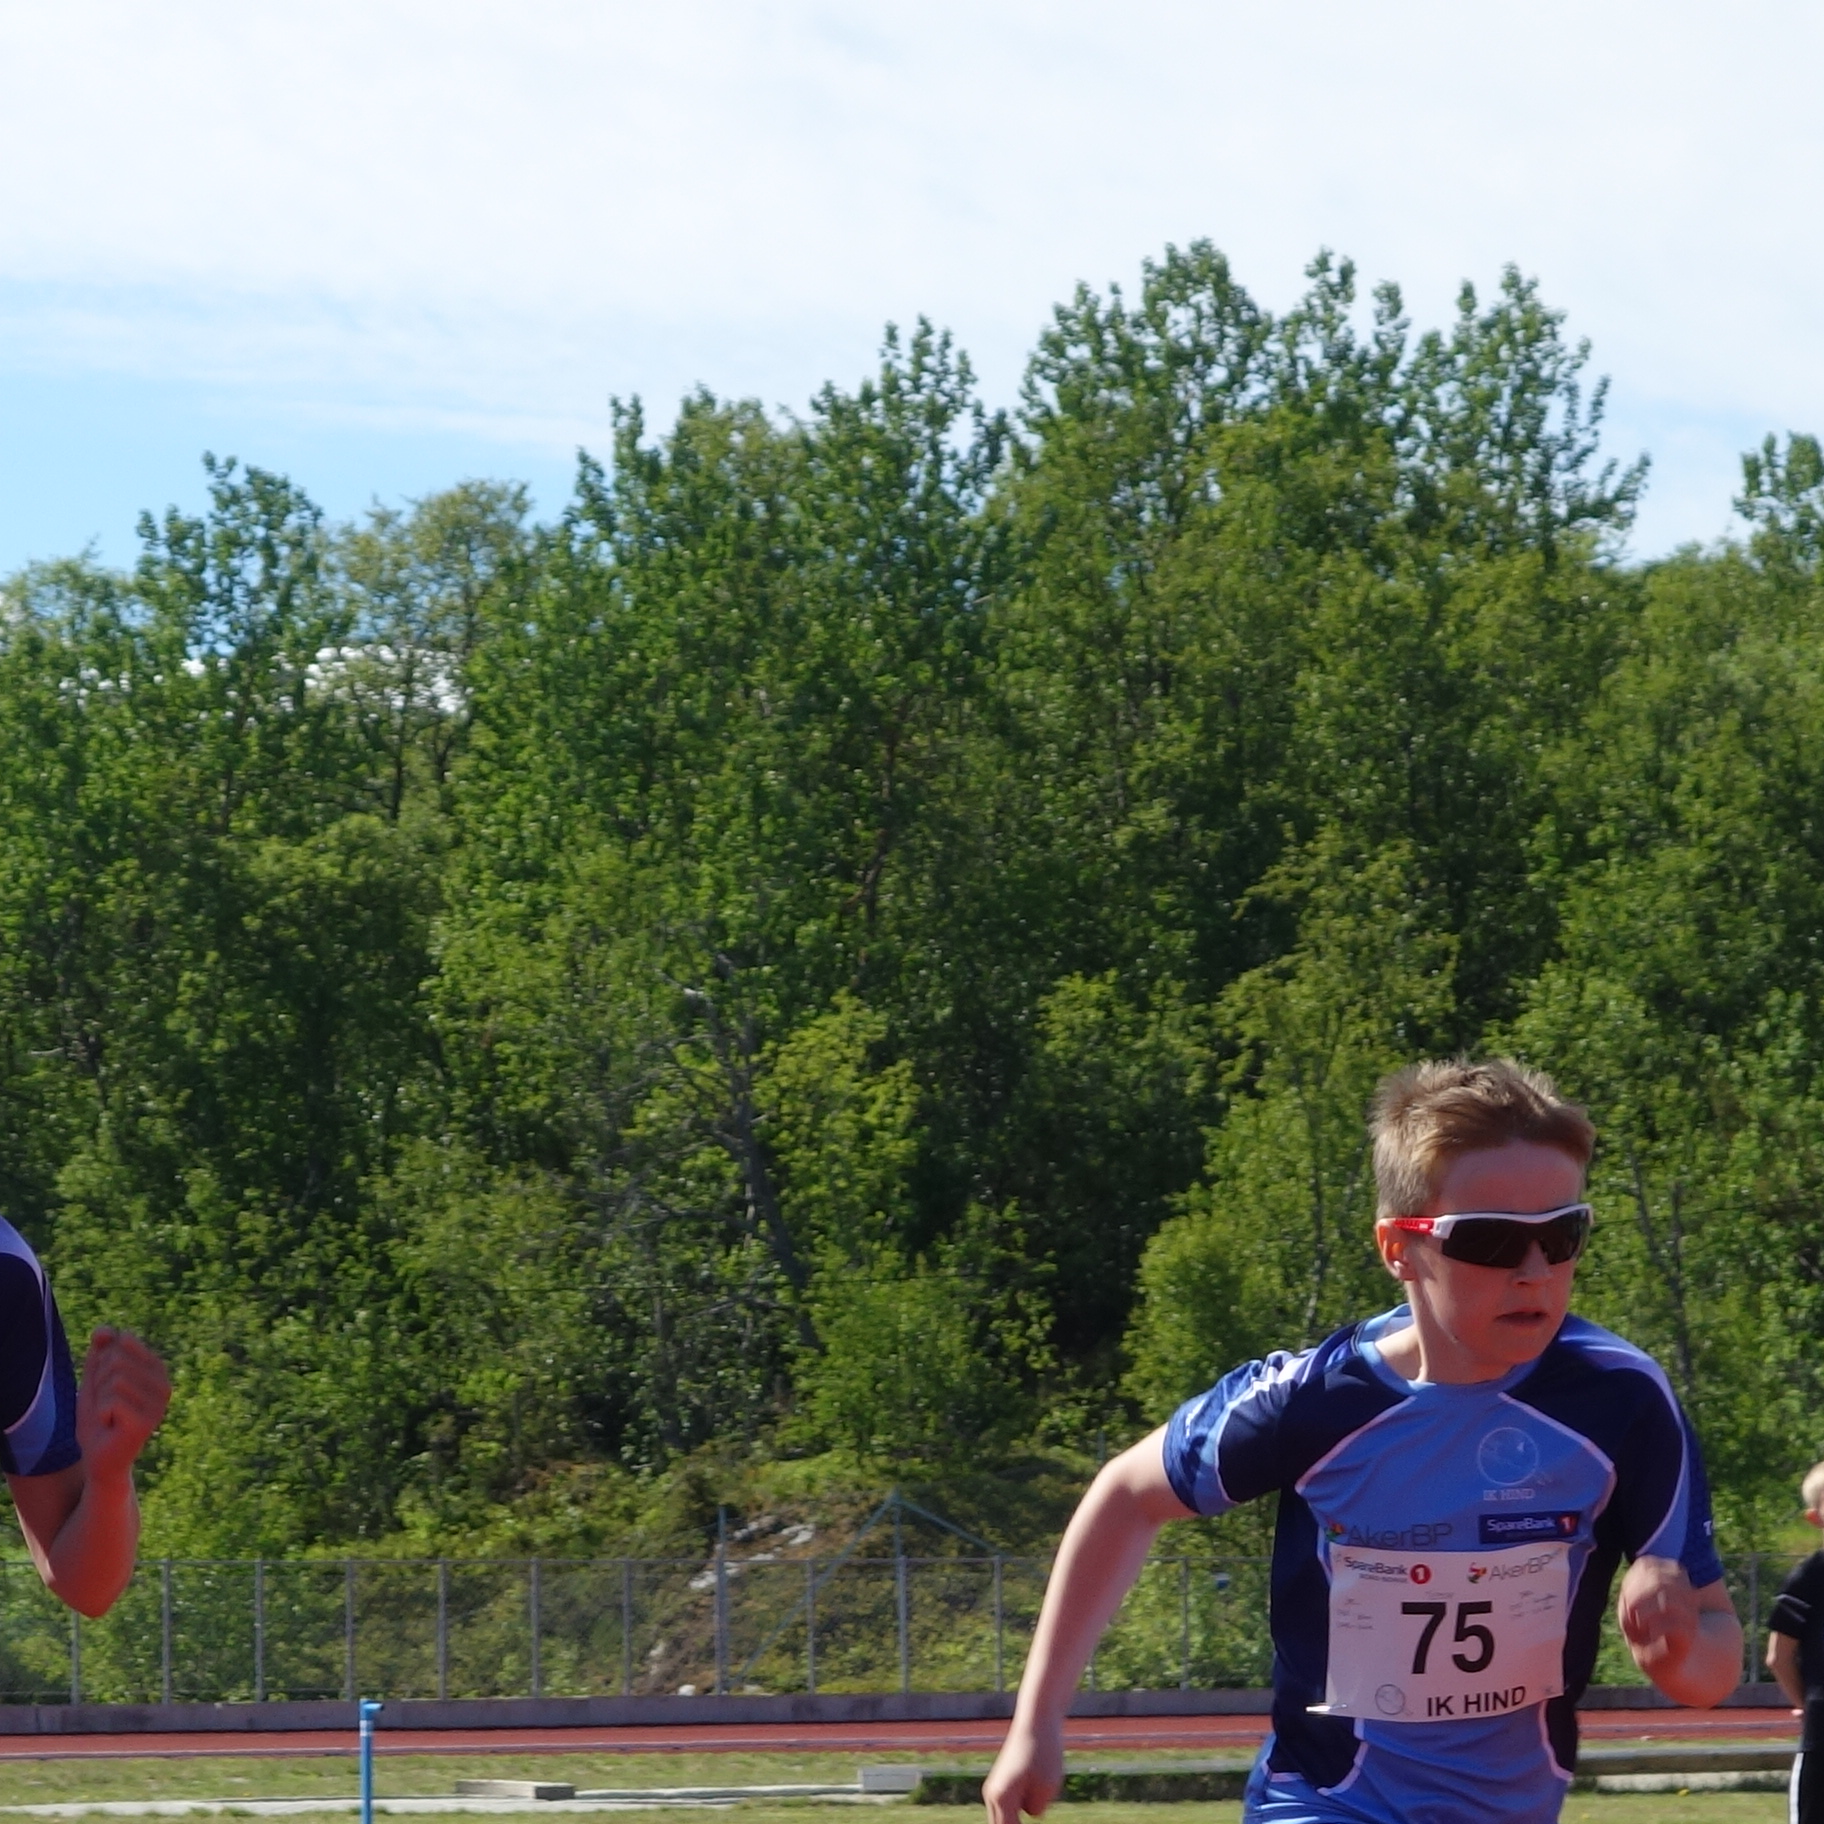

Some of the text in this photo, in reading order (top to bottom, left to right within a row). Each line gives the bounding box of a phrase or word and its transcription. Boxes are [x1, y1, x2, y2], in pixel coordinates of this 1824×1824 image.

[1347, 1522, 1453, 1548] AkerBP
[1486, 1516, 1556, 1532] SpareBank
[1344, 1556, 1408, 1576] SpareBank
[1488, 1553, 1552, 1581] AkerBP
[1401, 1600, 1496, 1675] 75
[1427, 1686, 1526, 1717] IK HIND
